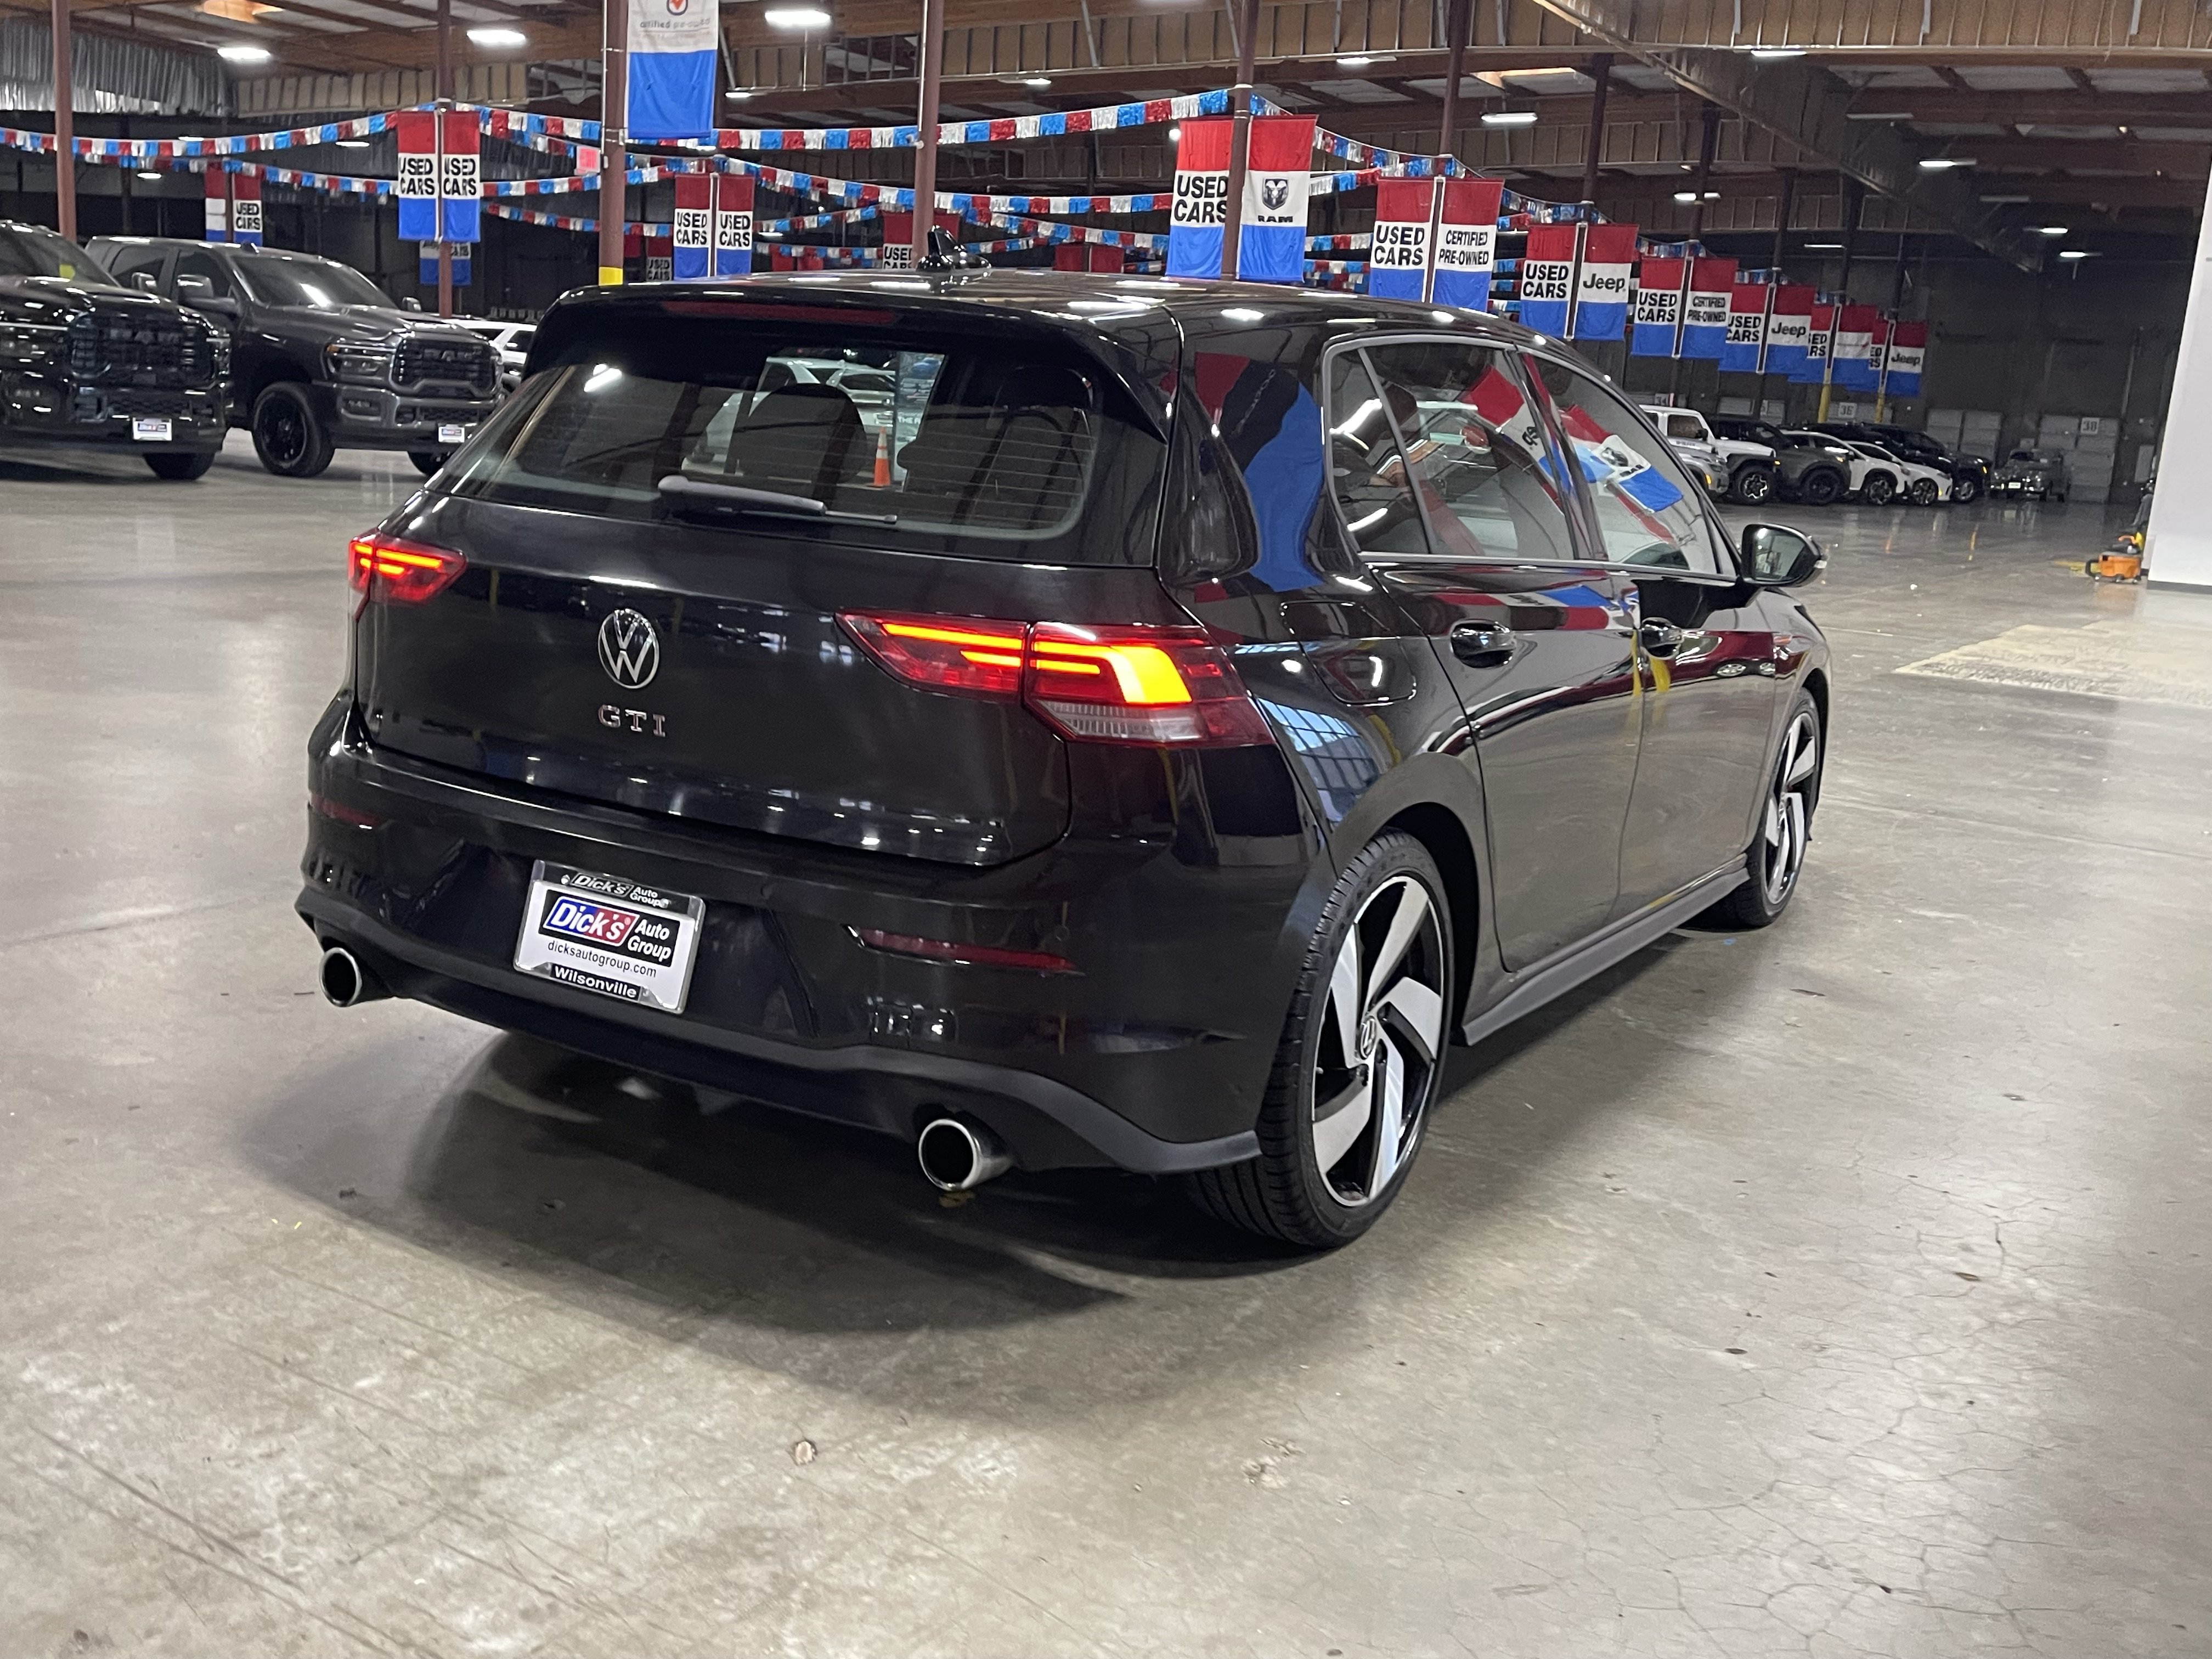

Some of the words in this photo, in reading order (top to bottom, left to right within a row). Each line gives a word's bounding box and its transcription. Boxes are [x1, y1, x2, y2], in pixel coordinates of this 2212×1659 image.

[399, 157, 433, 176] USED
[444, 157, 476, 176] USED
[400, 177, 436, 195] CARS
[443, 178, 477, 196] CARS
[1177, 174, 1229, 199] USED
[676, 212, 708, 229] USED
[720, 213, 751, 230] USED
[676, 229, 708, 246] CARS
[719, 230, 751, 247] CARS
[1376, 224, 1425, 246] USED
[1446, 229, 1488, 246] CERTIFIED
[1374, 245, 1424, 266] CARS
[1438, 248, 1489, 266] PRE-OWNED
[1525, 263, 1569, 281] USED
[1522, 281, 1567, 298] CARS
[1582, 273, 1626, 293] Jeep
[1638, 291, 1678, 308] USED
[1637, 307, 1675, 323] CARS
[1771, 321, 1807, 338] Jeep
[598, 703, 667, 738] GTI
[574, 875, 627, 895] Dick's
[632, 886, 658, 898] Auto
[550, 902, 625, 940] Dick's
[634, 918, 670, 940] Auto
[627, 935, 672, 962] Group
[548, 940, 657, 978] dicksautogroup.com
[554, 965, 637, 998] Wilsonville
